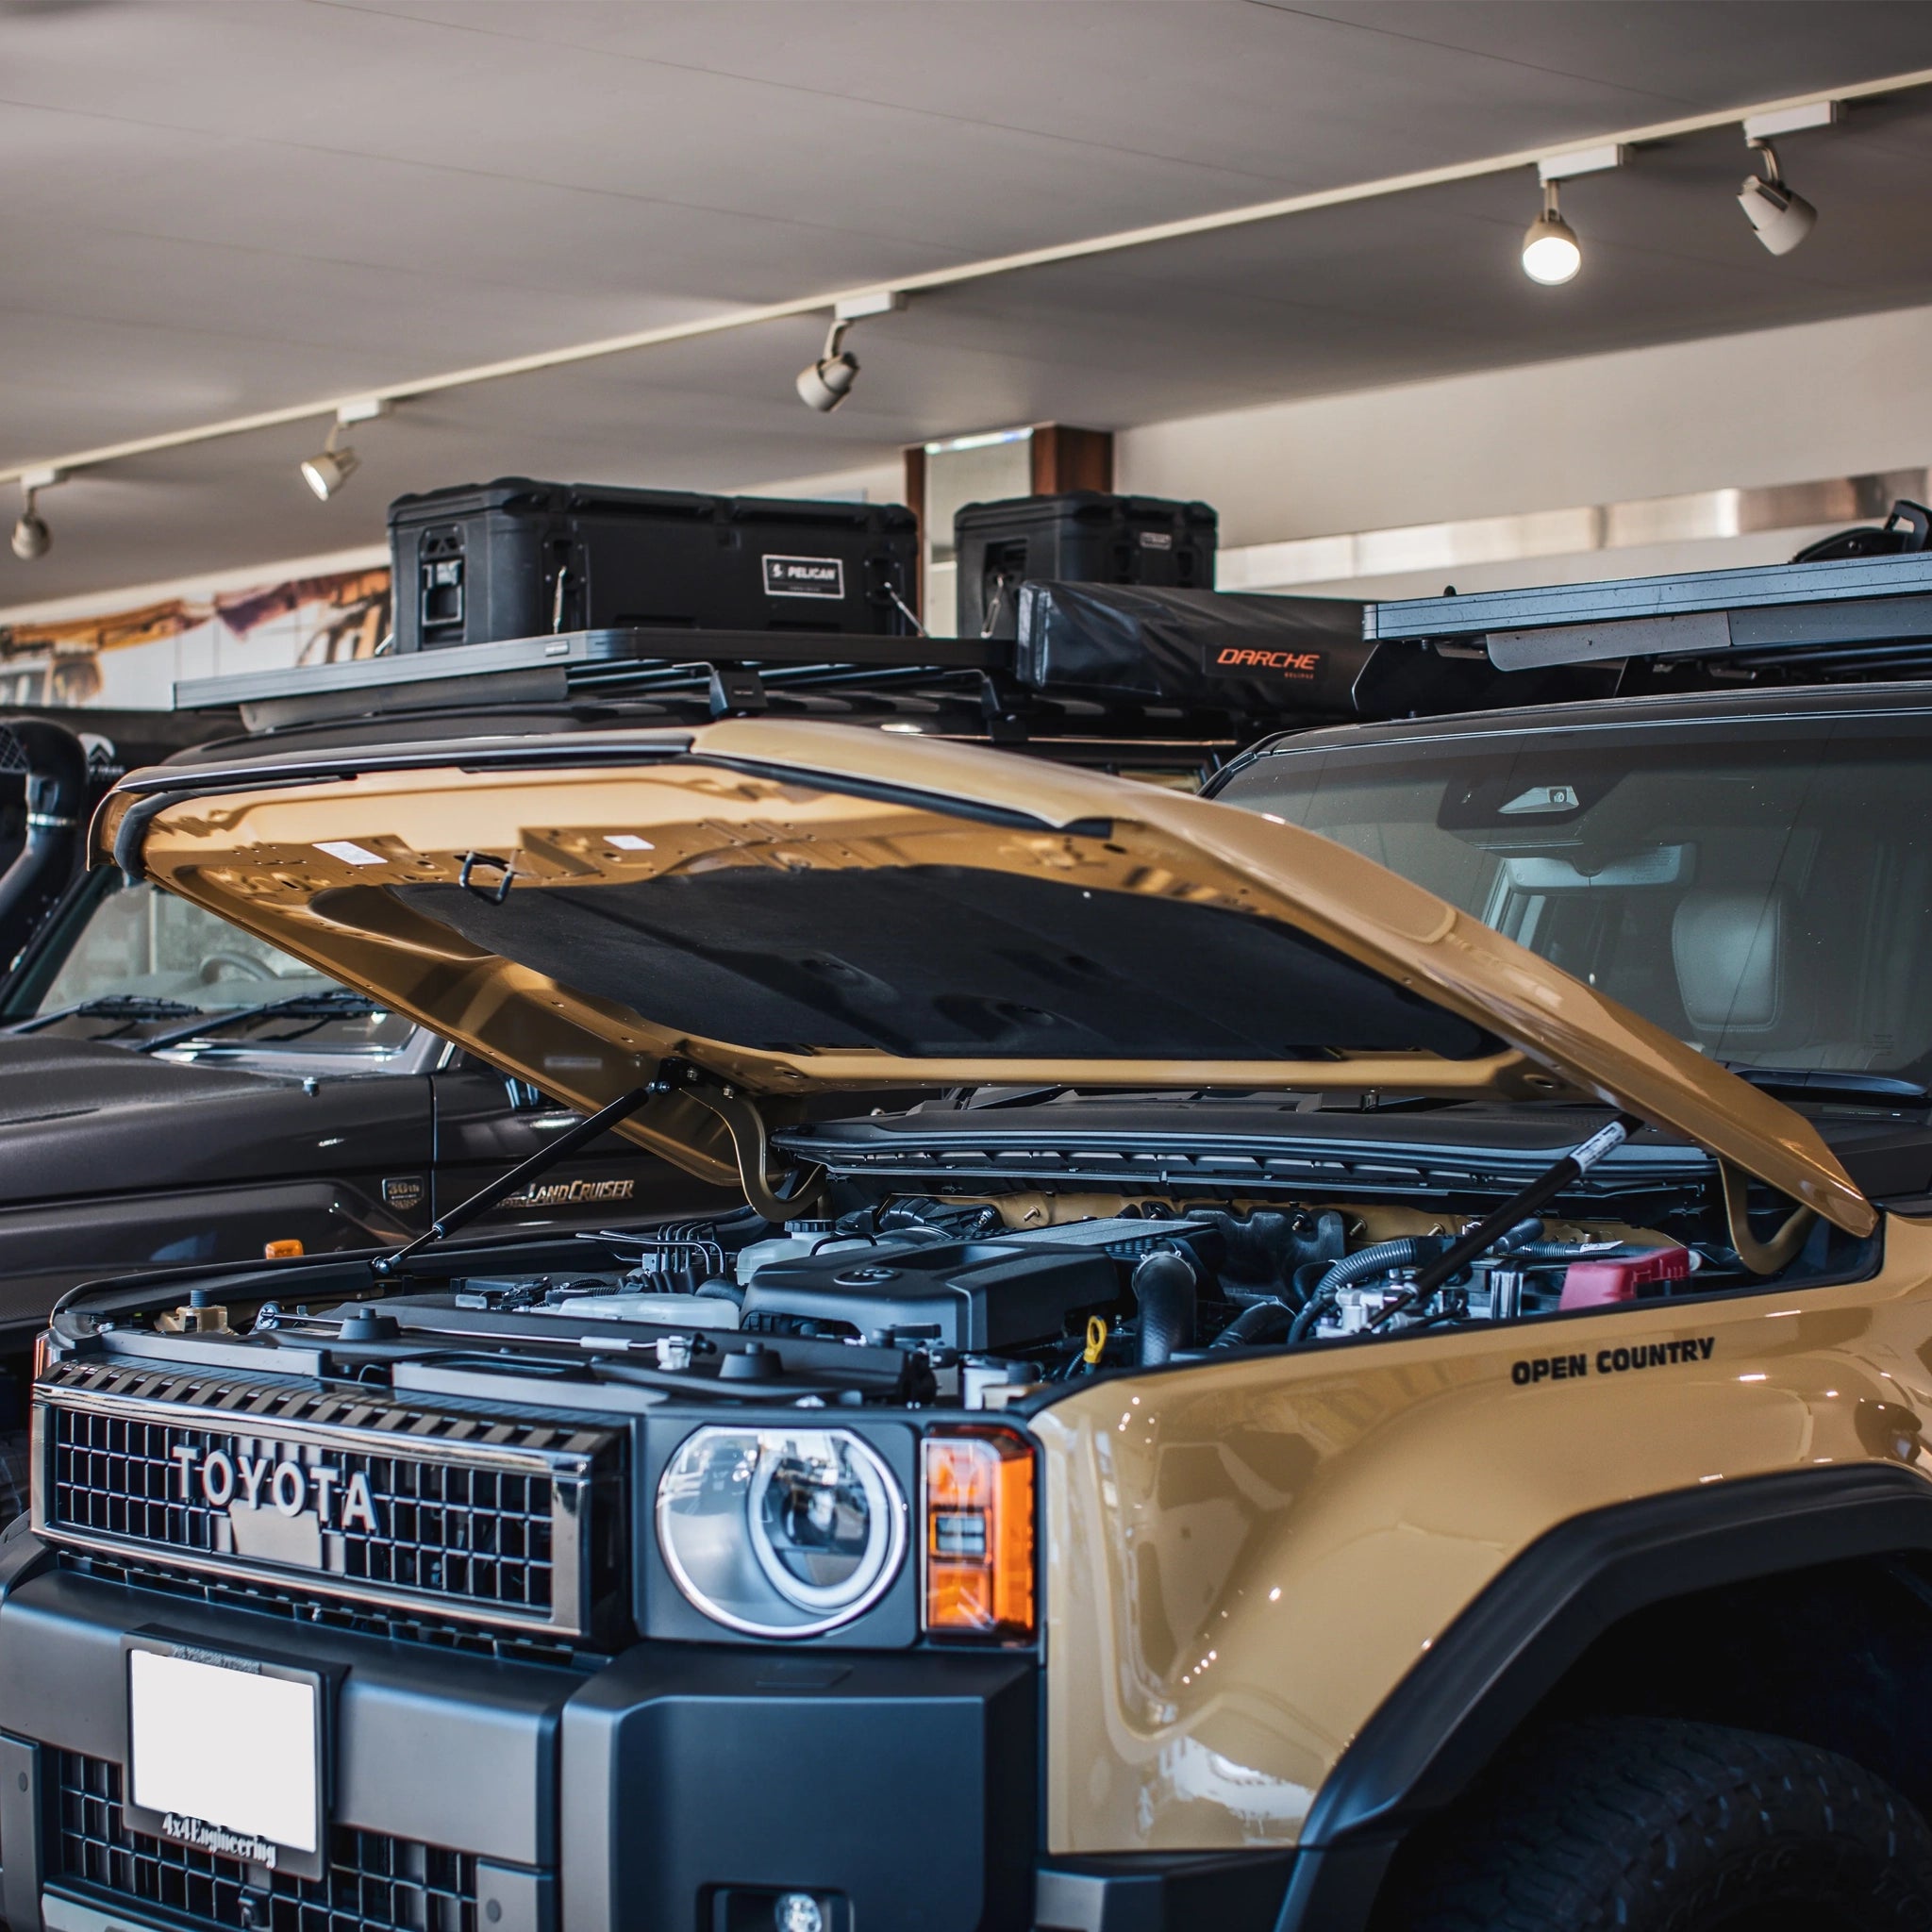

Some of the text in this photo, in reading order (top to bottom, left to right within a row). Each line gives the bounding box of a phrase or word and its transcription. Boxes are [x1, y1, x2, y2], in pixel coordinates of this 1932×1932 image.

[787, 566, 837, 580] PELICAN
[1217, 648, 1320, 671] DARCHE
[1511, 1336, 1715, 1386] OPEN COUNTRY
[173, 1444, 379, 1531] TOYOTA
